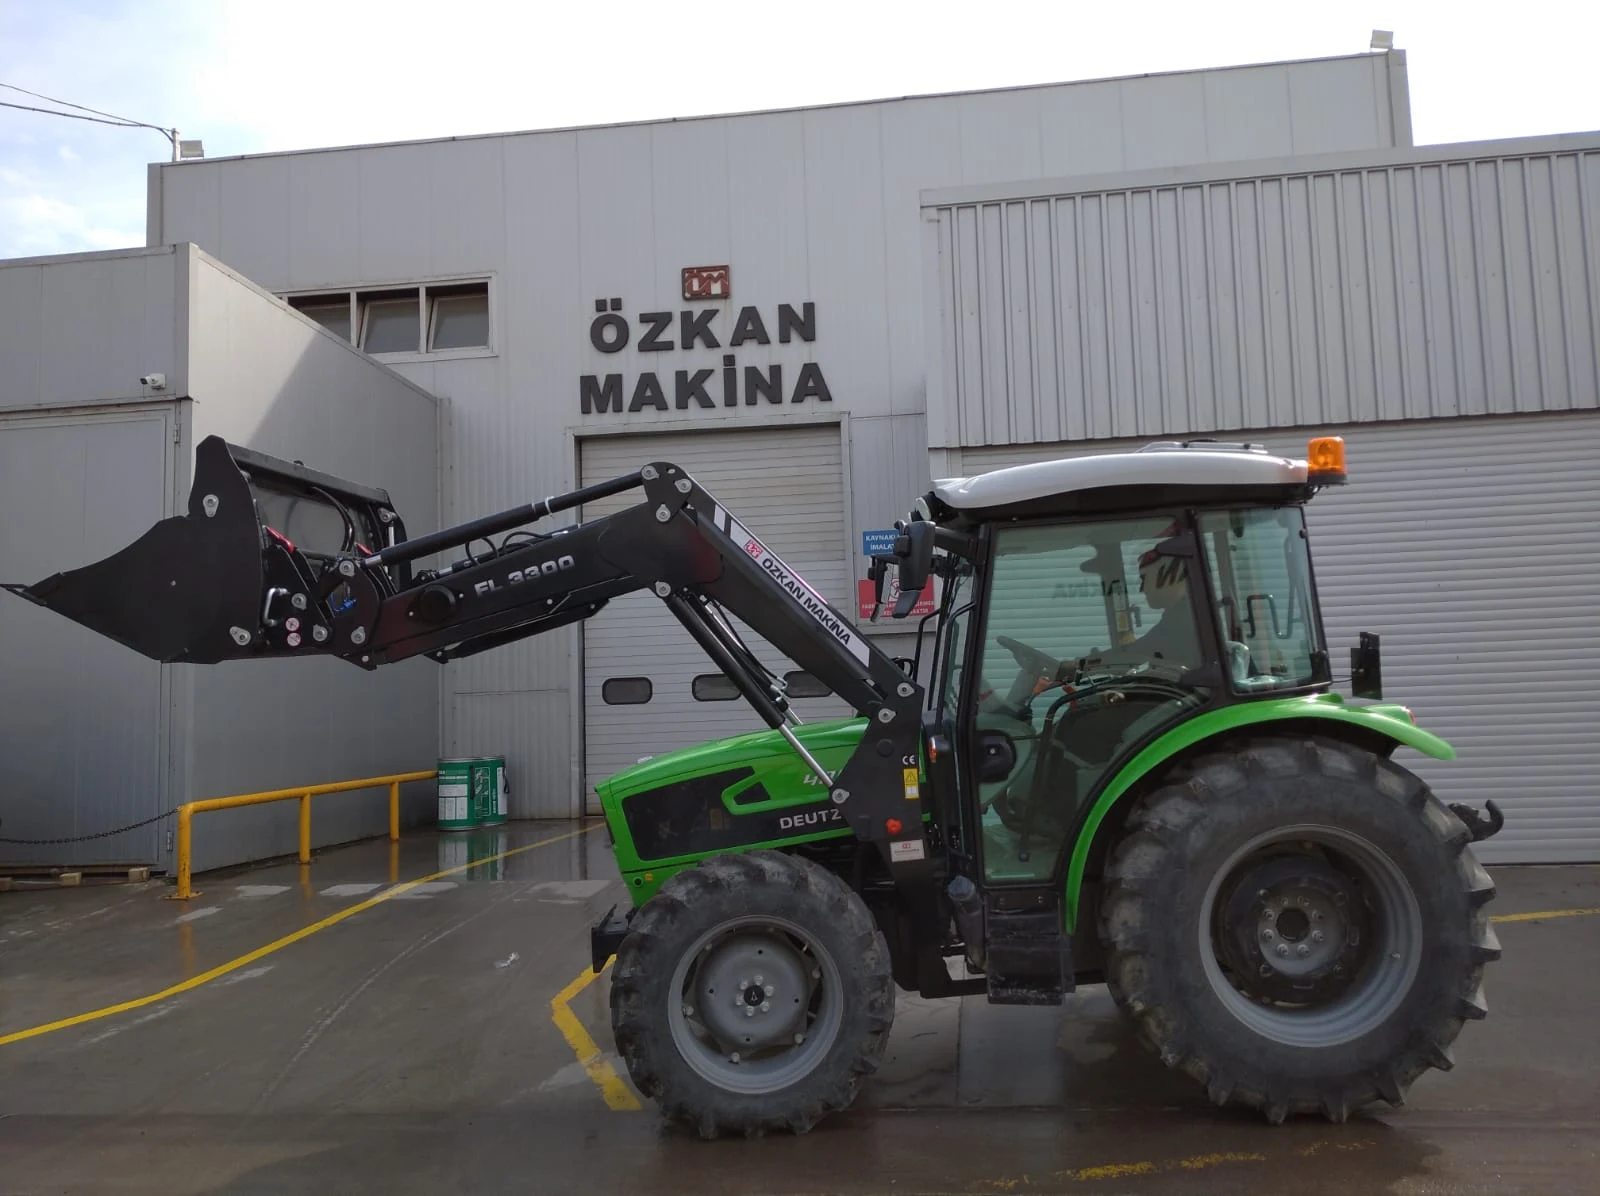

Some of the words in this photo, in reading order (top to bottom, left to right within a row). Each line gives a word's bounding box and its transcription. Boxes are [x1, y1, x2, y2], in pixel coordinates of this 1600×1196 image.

[590, 297, 816, 354] ÖZKAN
[579, 354, 833, 414] MAKİNA
[474, 579, 504, 597] FL
[508, 554, 576, 585] 3300
[762, 557, 805, 601] ÖZKAN
[804, 596, 851, 646] MAKİNA
[779, 808, 842, 830] DEUTZ
